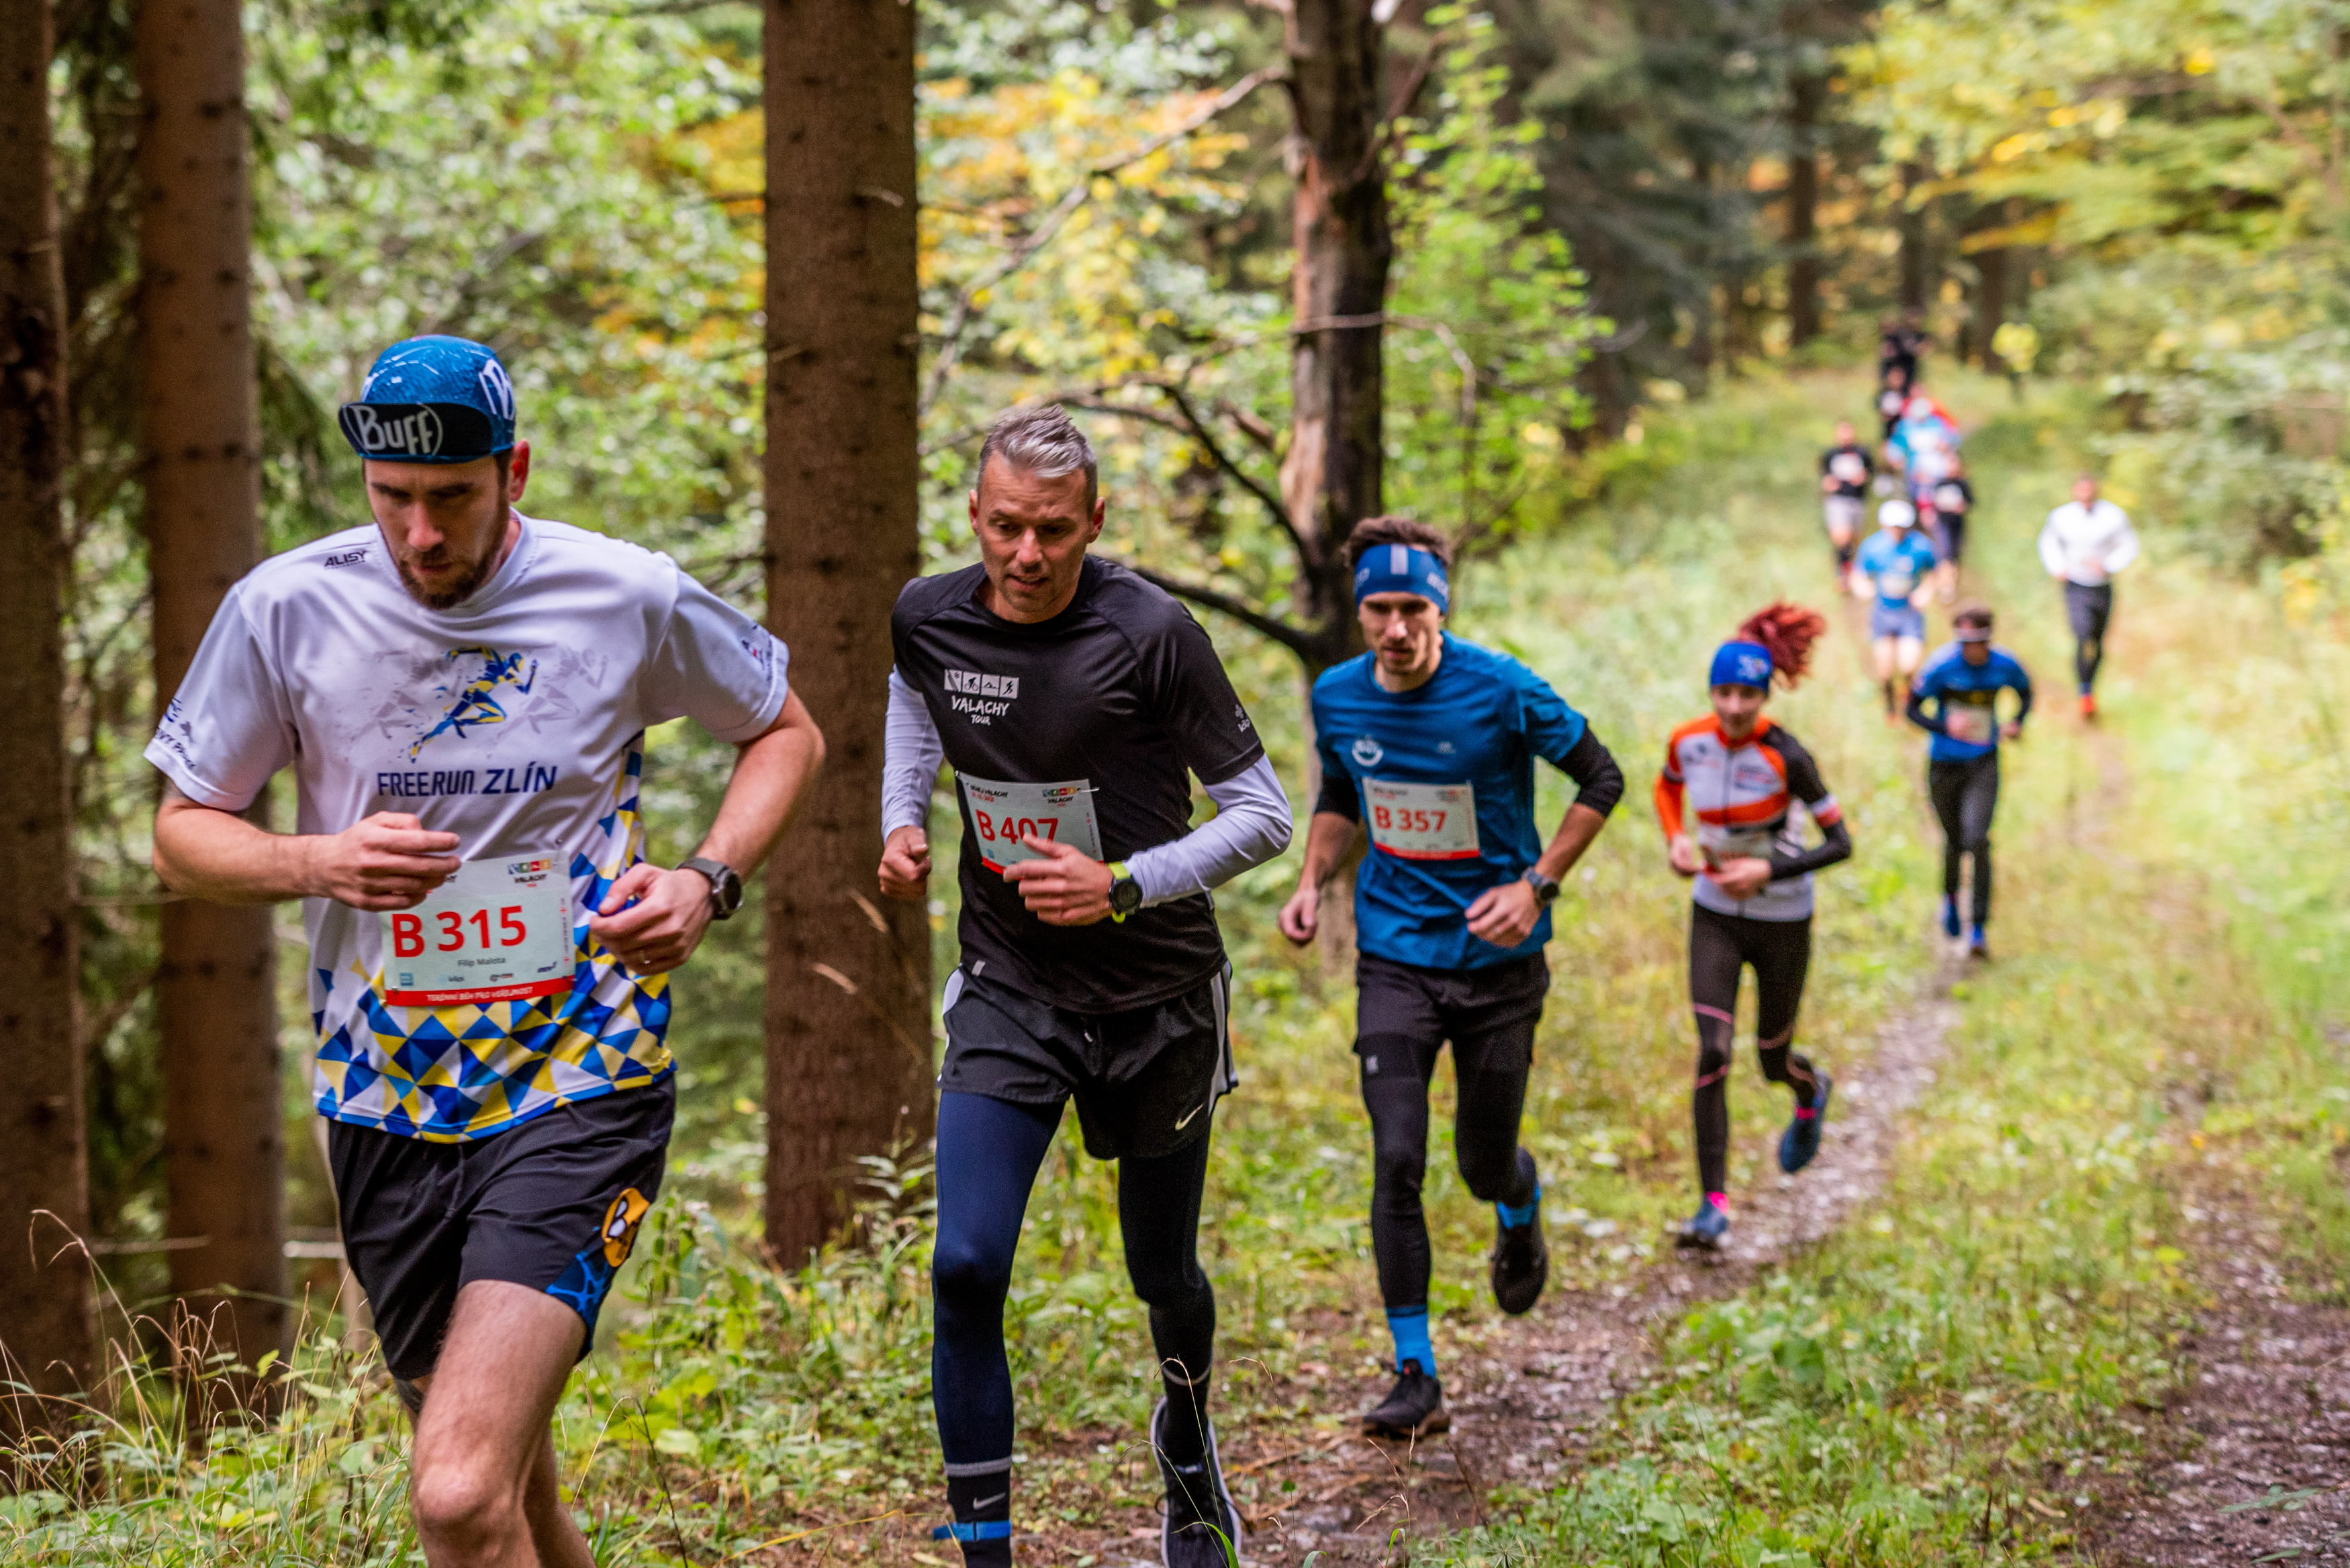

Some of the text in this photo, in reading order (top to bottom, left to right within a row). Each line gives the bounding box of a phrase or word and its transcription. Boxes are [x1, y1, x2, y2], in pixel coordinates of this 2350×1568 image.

[324, 550, 367, 567] ALISY
[951, 695, 1010, 716] VALACHY
[971, 714, 991, 726] TOUR
[377, 761, 558, 797] FREERUN ZLÍN
[976, 809, 995, 841] B
[1000, 817, 1059, 844] 407
[1374, 805, 1447, 834] B 357
[391, 914, 426, 957] B
[435, 905, 526, 952] 315
